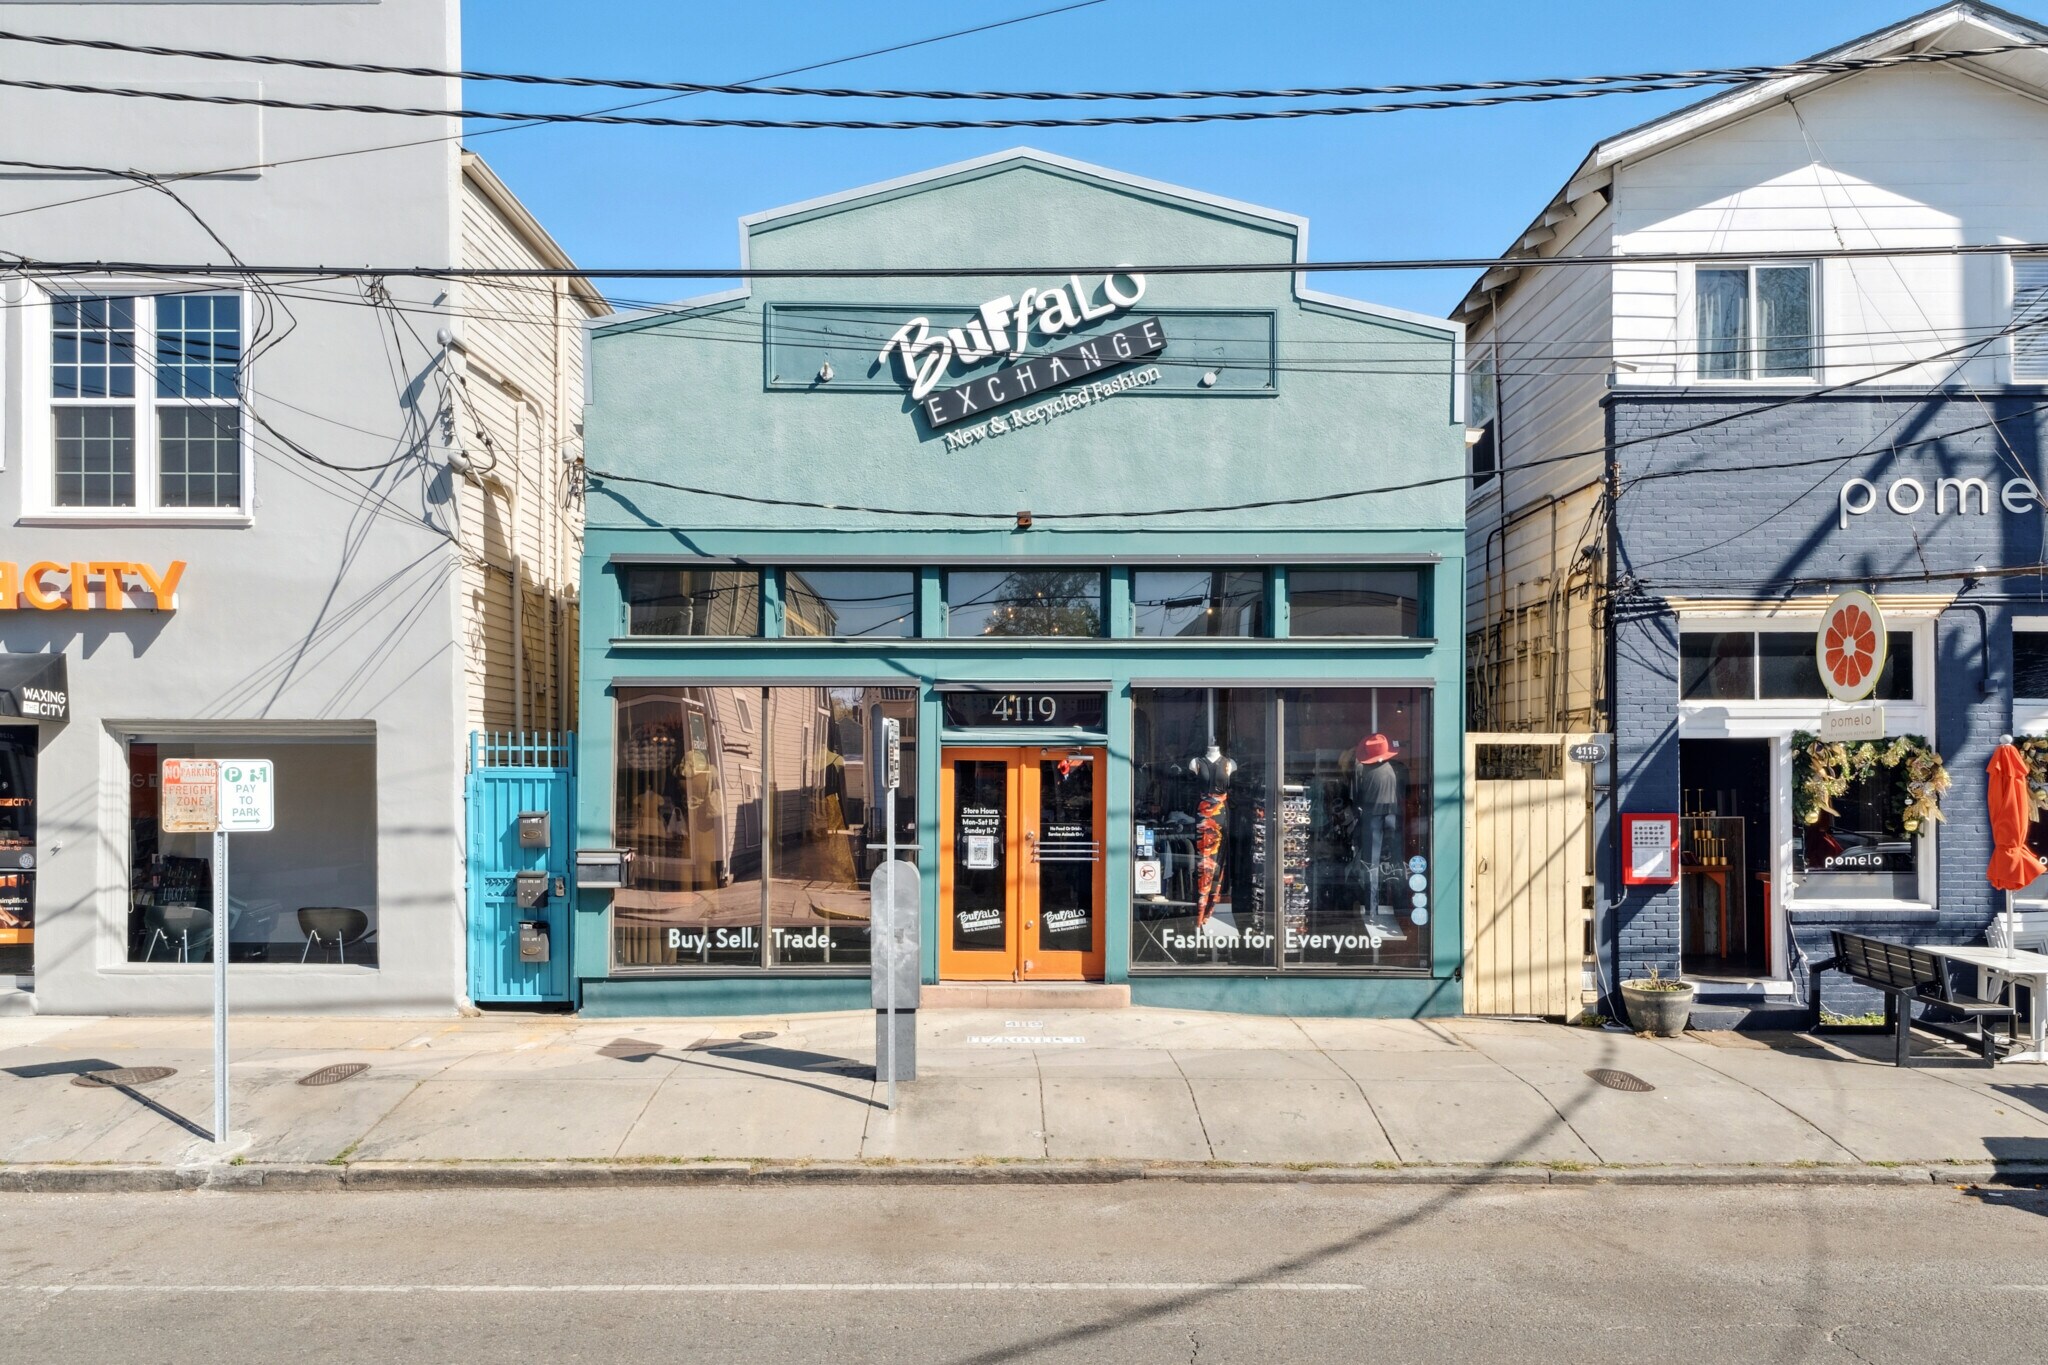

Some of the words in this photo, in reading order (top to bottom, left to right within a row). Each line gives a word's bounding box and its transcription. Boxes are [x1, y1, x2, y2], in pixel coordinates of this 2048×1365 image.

[927, 321, 1164, 424] EXCHANGE
[946, 423, 988, 450] New
[988, 416, 1010, 435] &
[1013, 386, 1091, 428] Recycled
[1094, 365, 1163, 400] Fashion
[23, 559, 187, 611] CITY
[23, 686, 66, 704] WAXING
[40, 703, 66, 717] CITY
[992, 695, 1057, 722] 4119
[1831, 713, 1872, 731] pomelo
[1576, 746, 1599, 755] 4115
[165, 765, 180, 780] NO
[181, 767, 216, 778] PARKING
[169, 785, 213, 795] FREIGHT
[236, 784, 256, 793] PAY
[13, 798, 33, 806] CITY
[176, 796, 205, 806] ZONE
[239, 796, 253, 804] TO
[232, 808, 260, 816] PARK
[964, 827, 986, 835] Sunday
[1825, 854, 1882, 868] pomelo
[668, 928, 712, 954] Buy.
[716, 927, 759, 948] Sell.
[771, 927, 837, 949] Trade.
[1162, 926, 1240, 949] Fashion
[1242, 927, 1275, 949] for
[1285, 928, 1382, 953] Everyone
